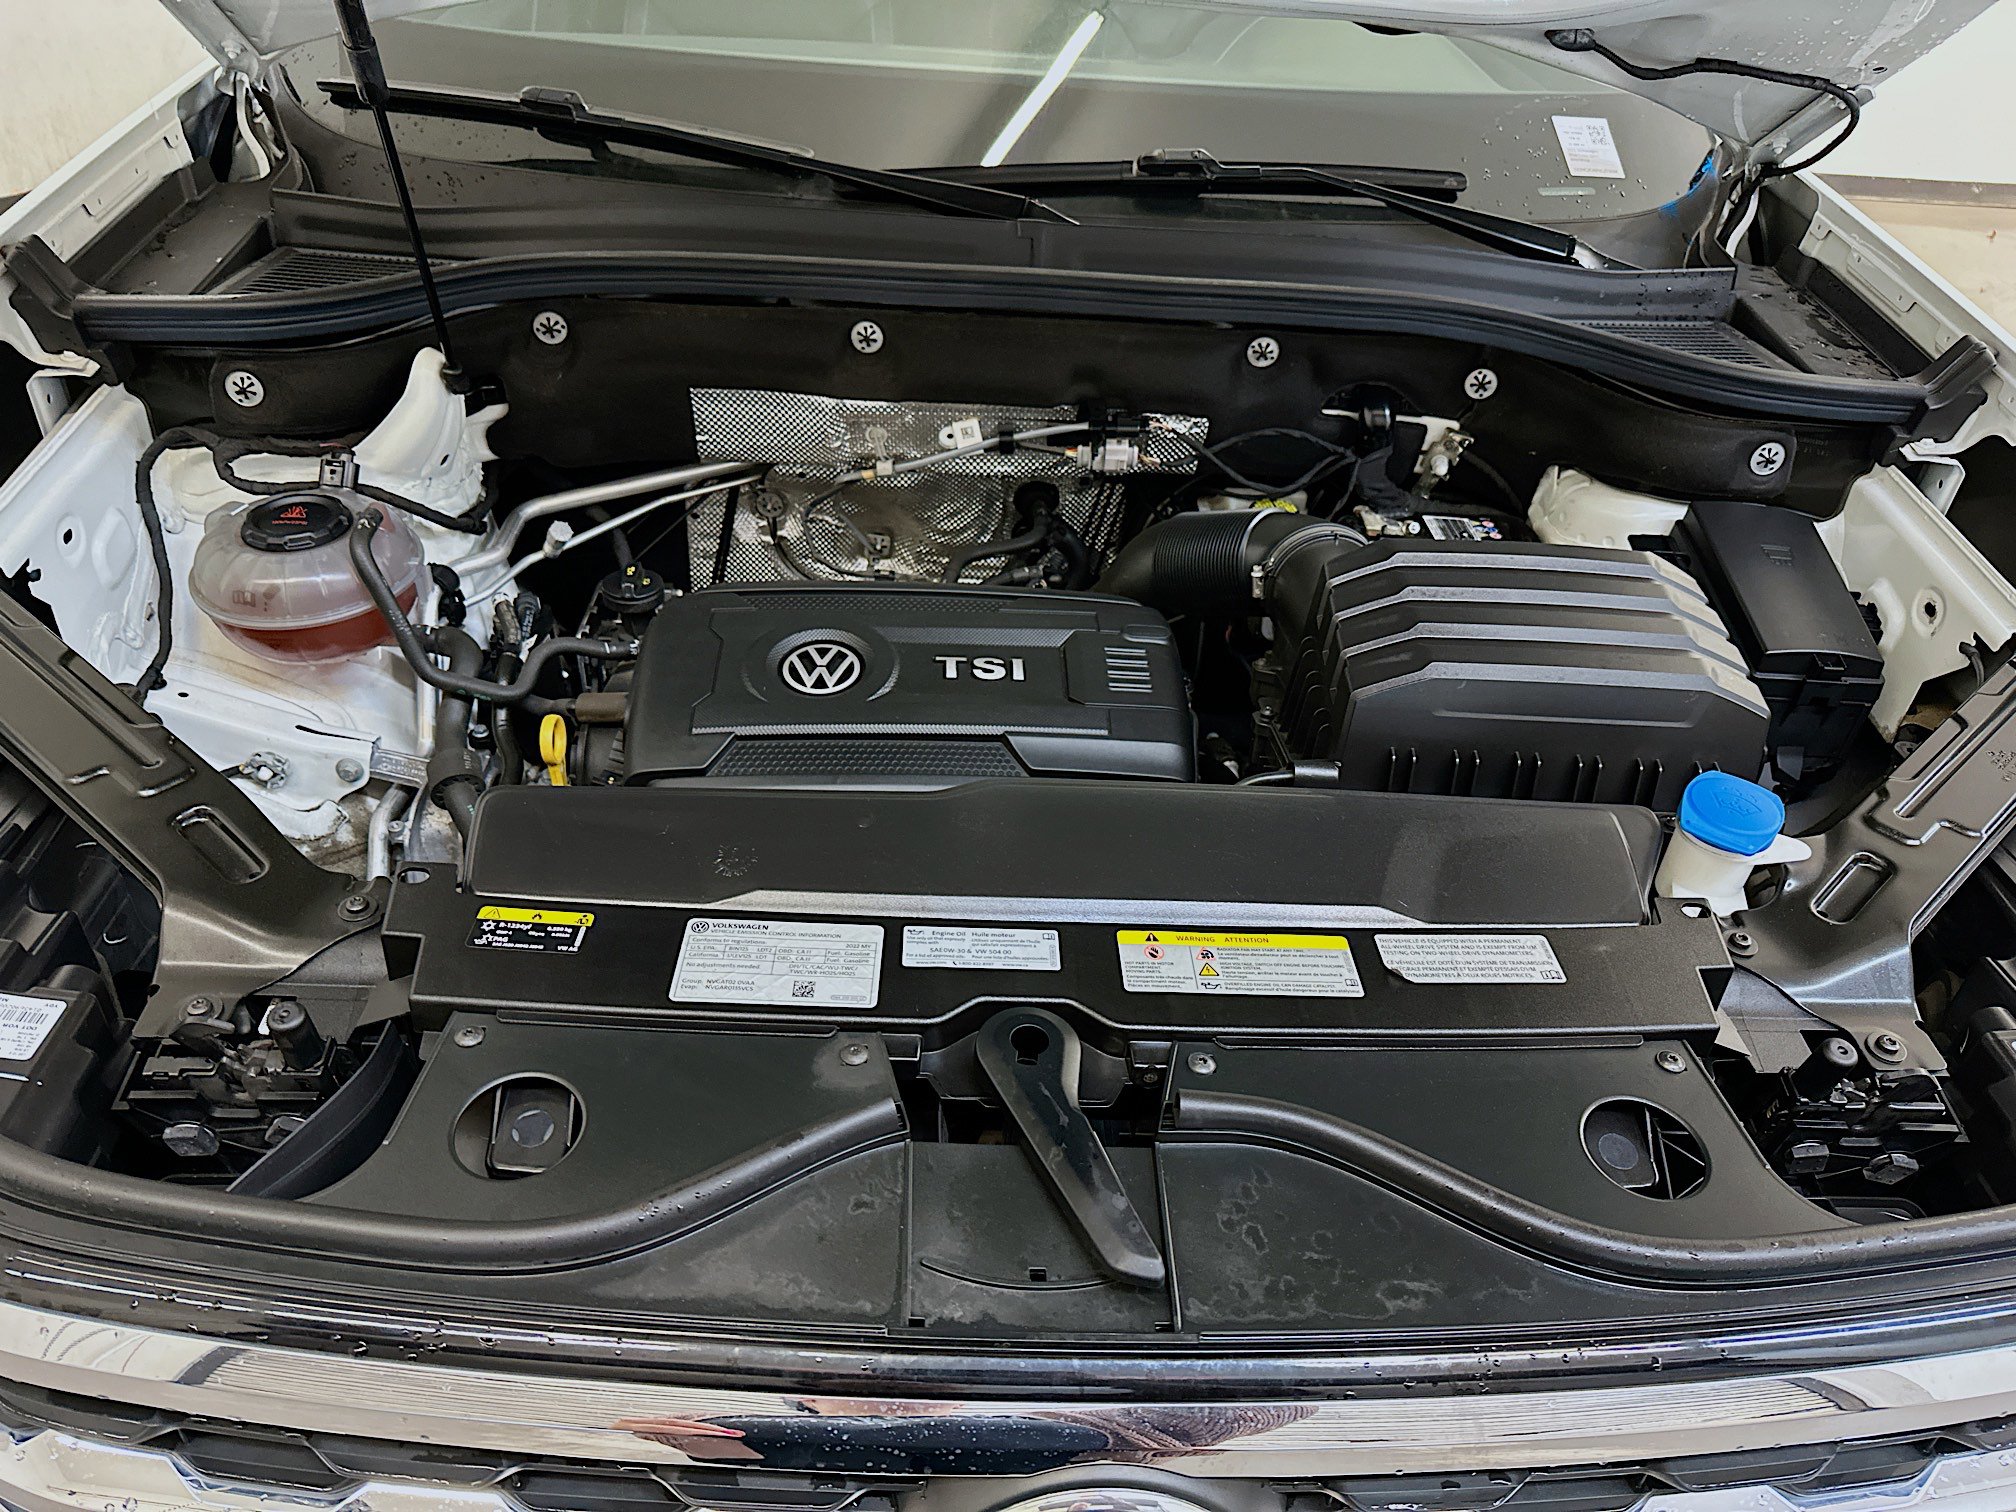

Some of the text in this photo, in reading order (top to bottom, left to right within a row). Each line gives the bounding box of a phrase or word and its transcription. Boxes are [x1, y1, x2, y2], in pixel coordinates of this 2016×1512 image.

[934, 655, 1025, 682] TSI
[712, 922, 769, 930] VOLKSWAGEN
[932, 930, 954, 938] Engine
[1176, 935, 1216, 943] WARNING
